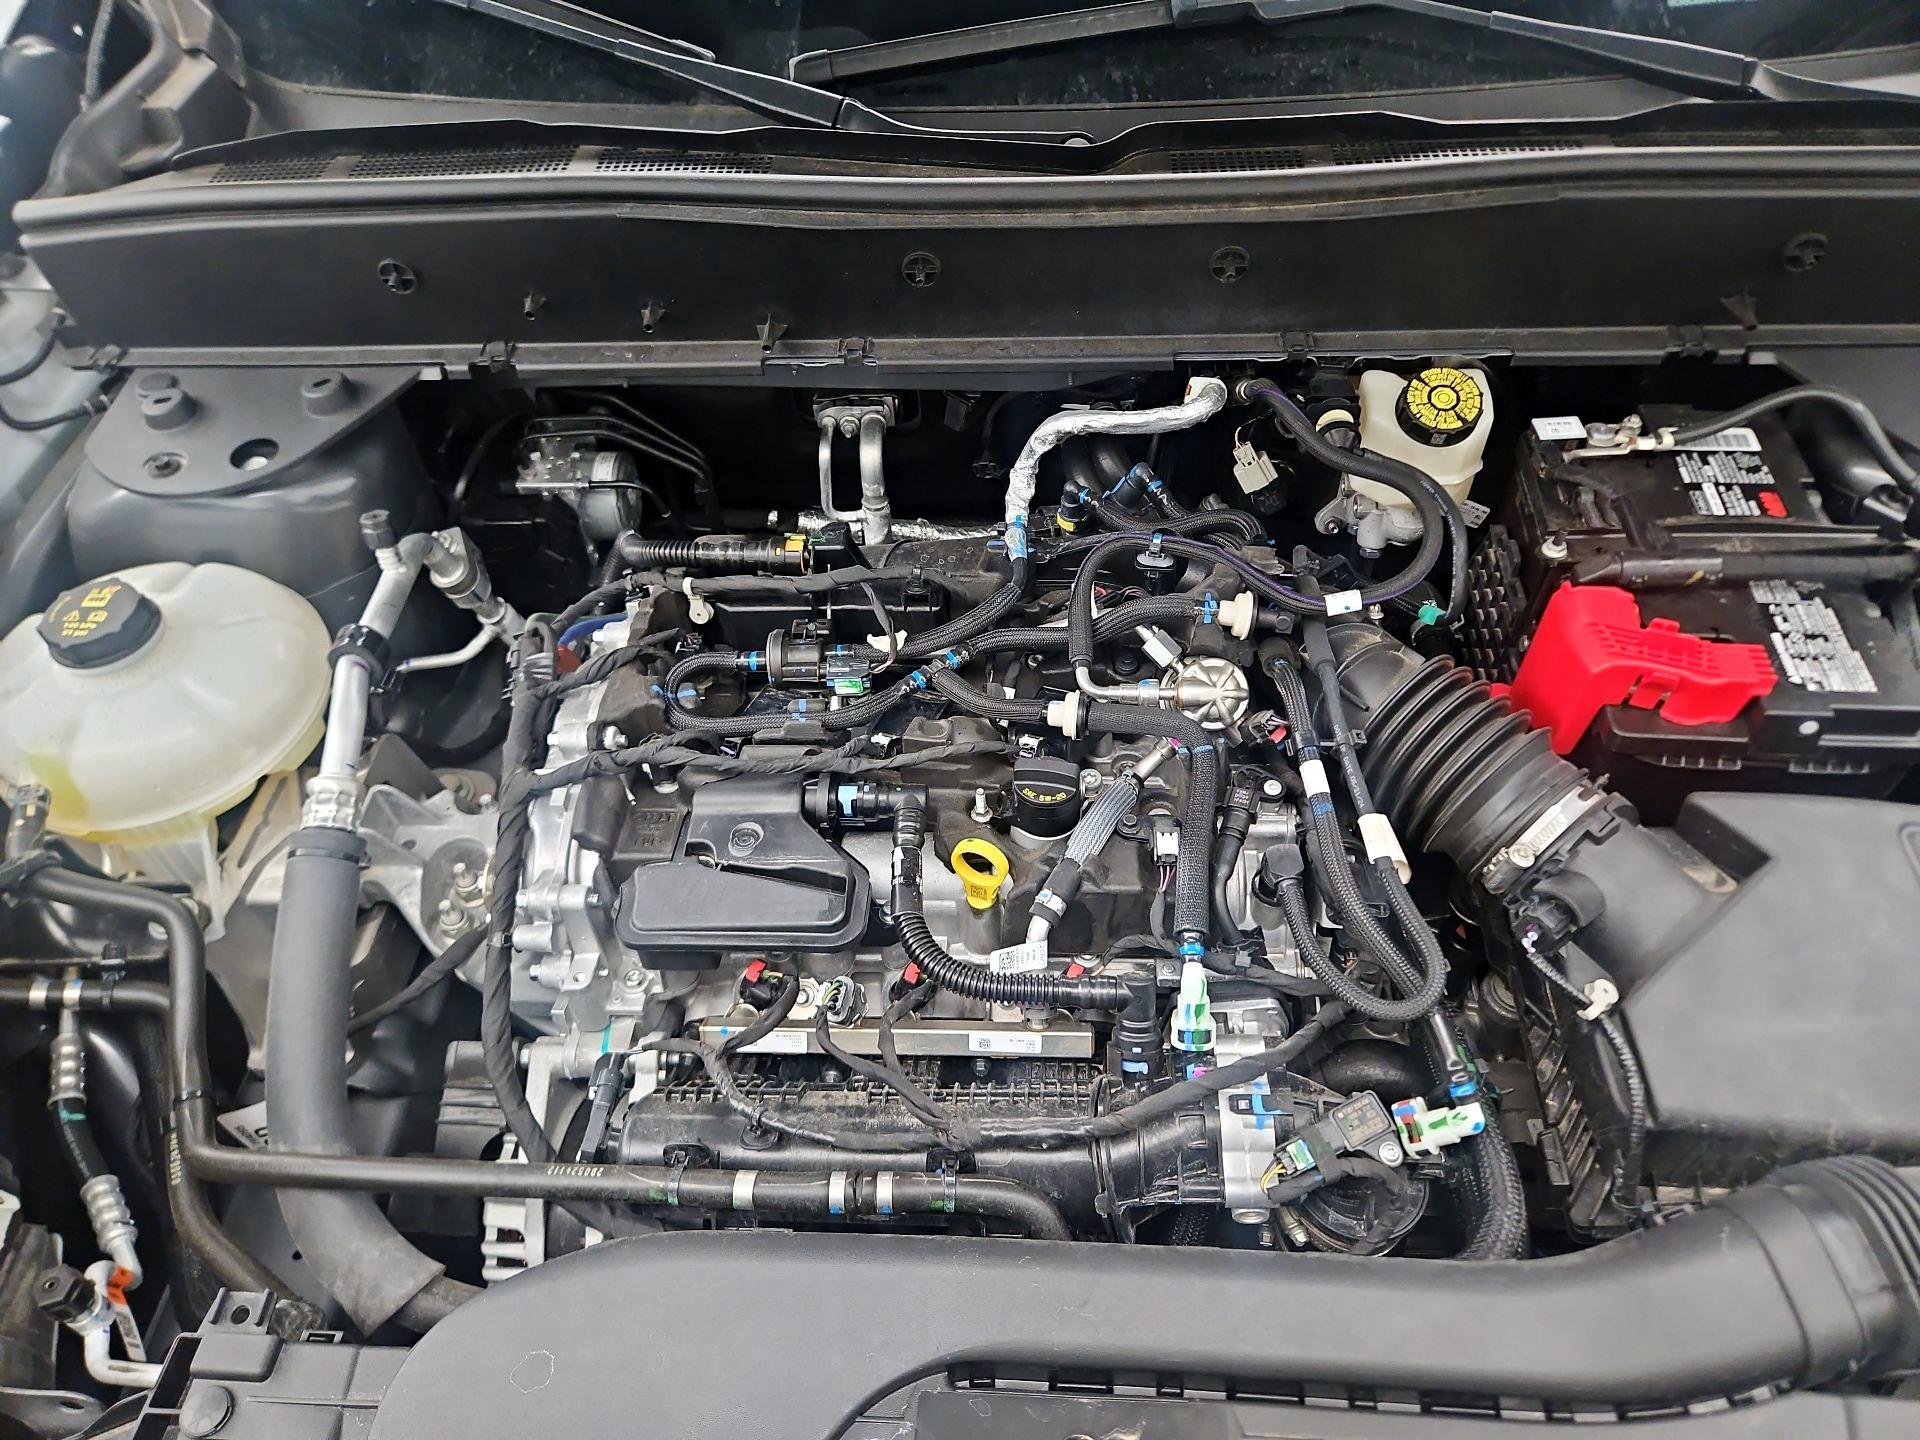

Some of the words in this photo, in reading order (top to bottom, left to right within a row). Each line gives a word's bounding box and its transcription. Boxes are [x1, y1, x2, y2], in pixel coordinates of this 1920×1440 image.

[1343, 756, 1353, 774] DATE
[1022, 787, 1037, 799] SAE
[1039, 792, 1067, 801] 5W-20
